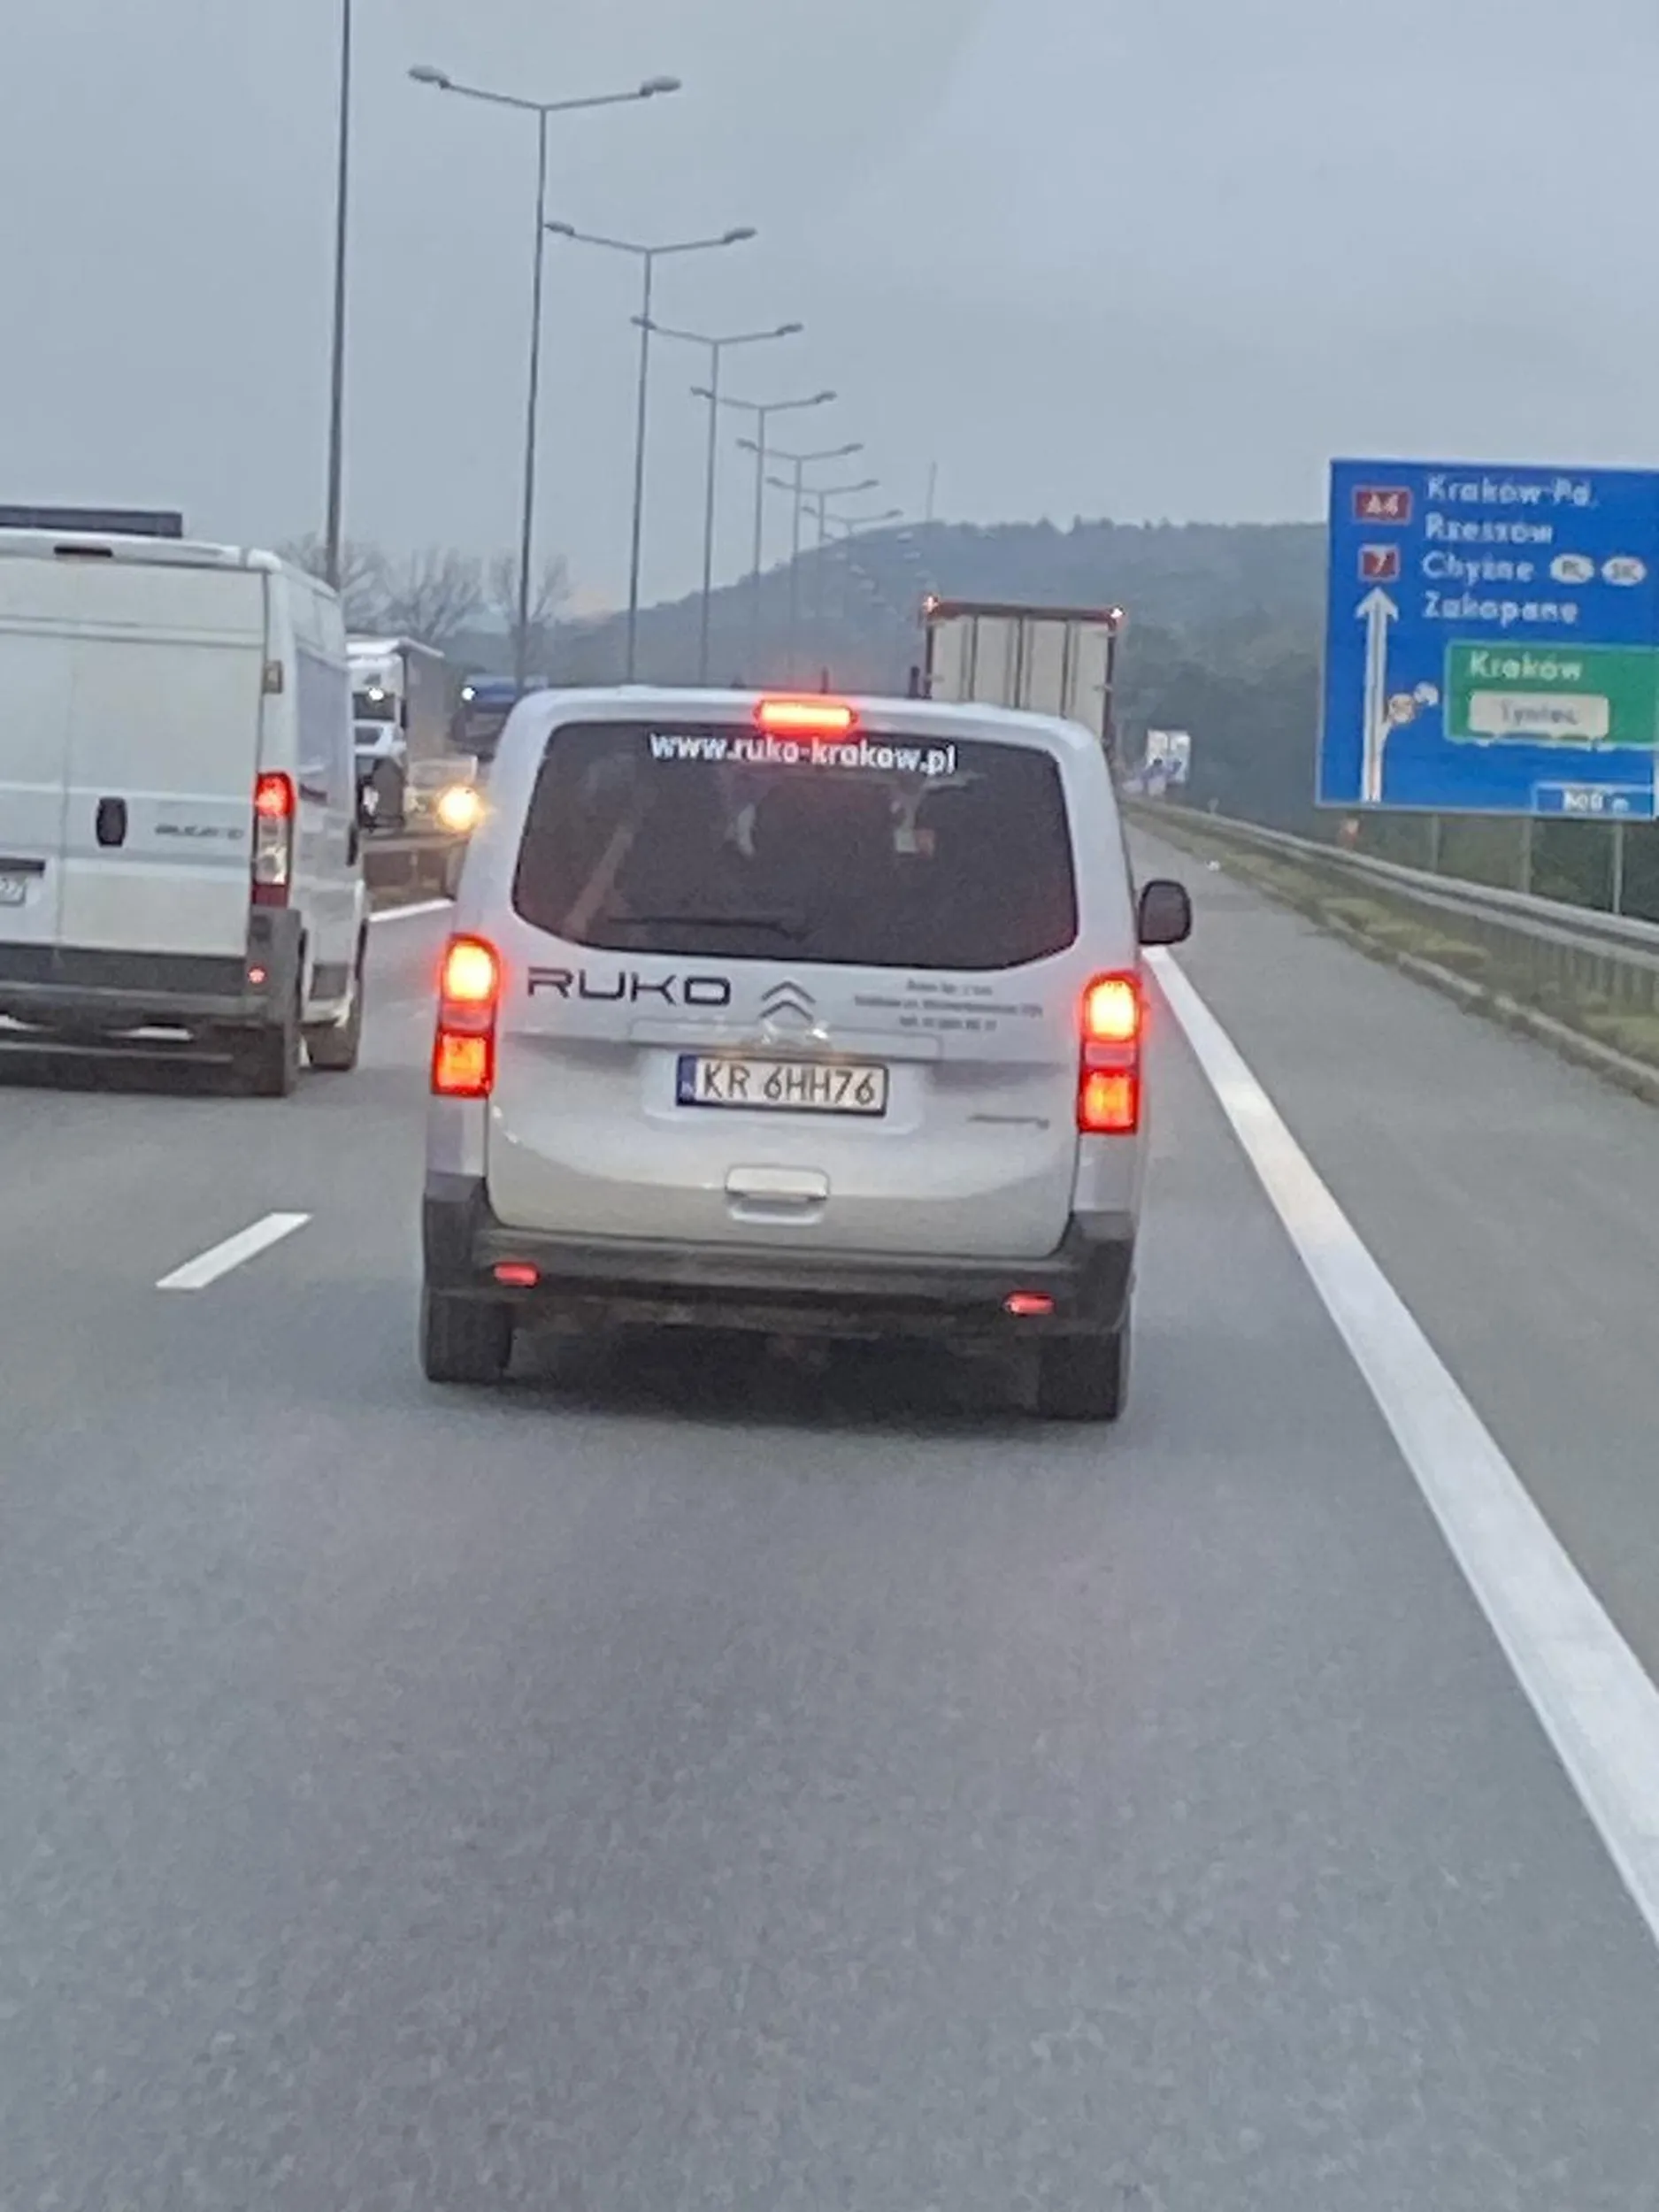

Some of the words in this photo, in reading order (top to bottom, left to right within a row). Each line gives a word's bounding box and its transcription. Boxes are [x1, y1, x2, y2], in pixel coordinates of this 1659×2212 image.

[1423, 590, 1578, 628] Zakopane
[649, 733, 956, 775] www.ruko-krakow.pl
[527, 966, 731, 1006] RUKO
[703, 1064, 751, 1099] KR
[763, 1067, 875, 1106] 6HH76
